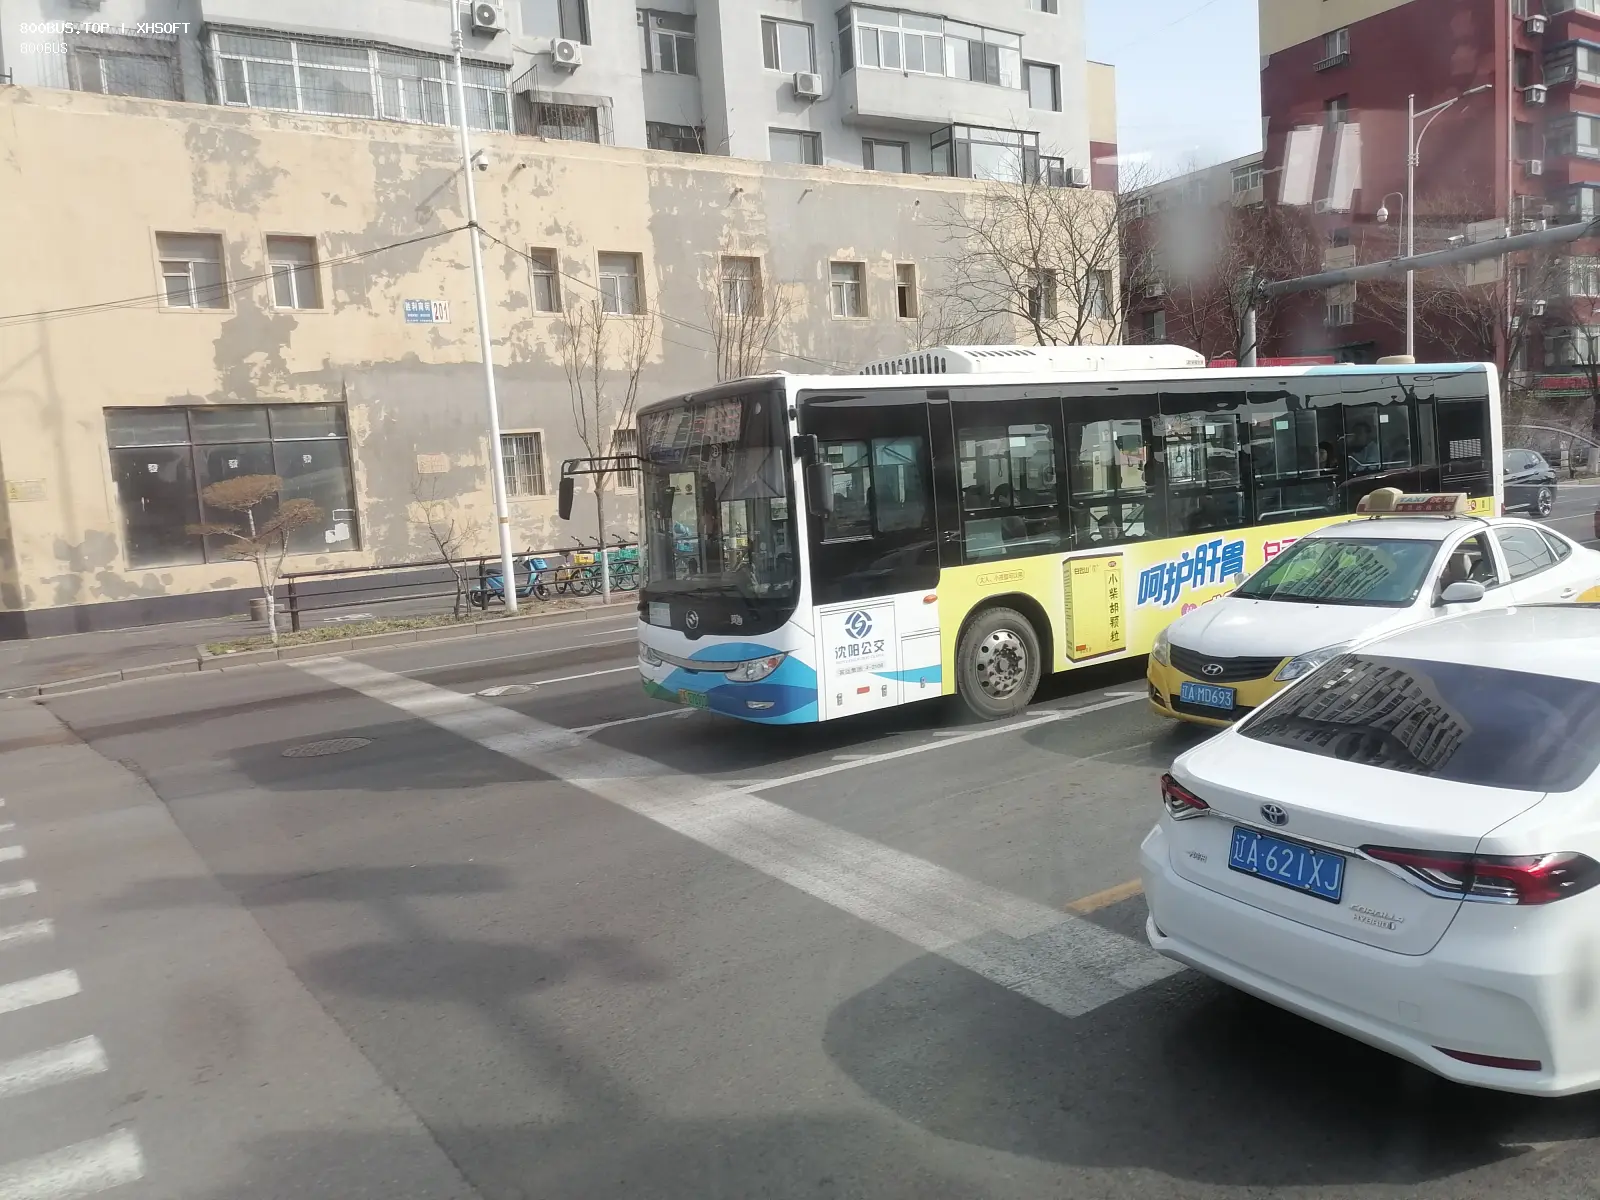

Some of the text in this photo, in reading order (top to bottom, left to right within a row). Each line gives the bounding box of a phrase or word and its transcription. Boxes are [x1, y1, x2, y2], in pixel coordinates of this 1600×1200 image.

[433, 302, 449, 321] 201
[1137, 539, 1244, 606] 呵护肝胃
[1108, 573, 1120, 642] 小柴胡颗粒
[835, 639, 885, 660] 沈阳公交
